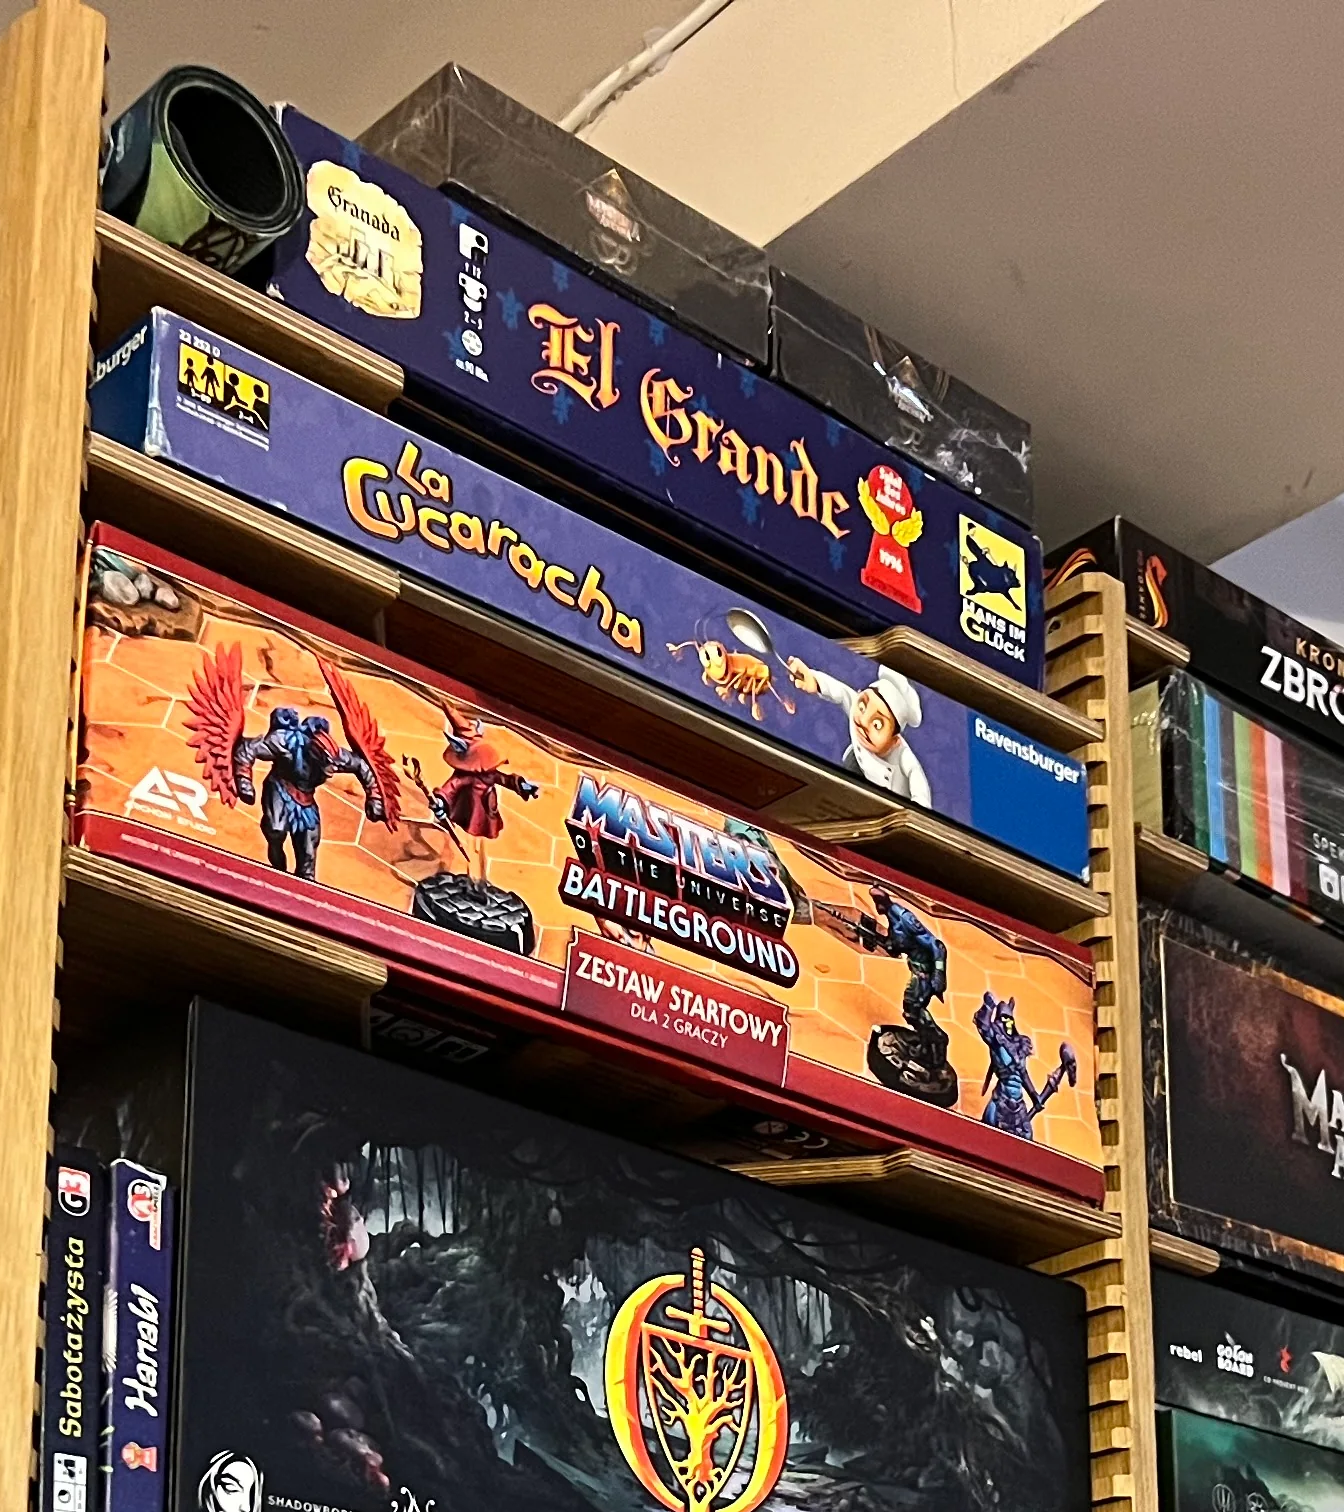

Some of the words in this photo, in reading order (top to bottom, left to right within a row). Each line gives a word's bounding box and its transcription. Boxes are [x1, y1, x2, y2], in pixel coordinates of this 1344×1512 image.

[328, 185, 401, 242] Granada
[527, 303, 622, 412] El
[641, 368, 852, 540] Grande
[396, 440, 452, 504] La
[342, 456, 645, 656] Cucaracha
[963, 597, 1006, 632] HANS
[1009, 621, 1027, 644] IM
[974, 717, 1081, 784] Ravensburger
[566, 769, 790, 908] MASTERS
[564, 863, 797, 979] BATTLEGROUND
[617, 850, 659, 879] THE
[676, 874, 784, 927] UNIVERSE
[575, 951, 666, 1005] ZESTAW
[668, 984, 784, 1047] STARTOWY
[630, 1002, 658, 1026] DLA
[662, 1013, 670, 1029] 2
[674, 1018, 729, 1049] GRACZY
[58, 1235, 93, 1440] Sabotażysta
[124, 1282, 160, 1418] Hanabi
[1169, 1343, 1203, 1363] rebel
